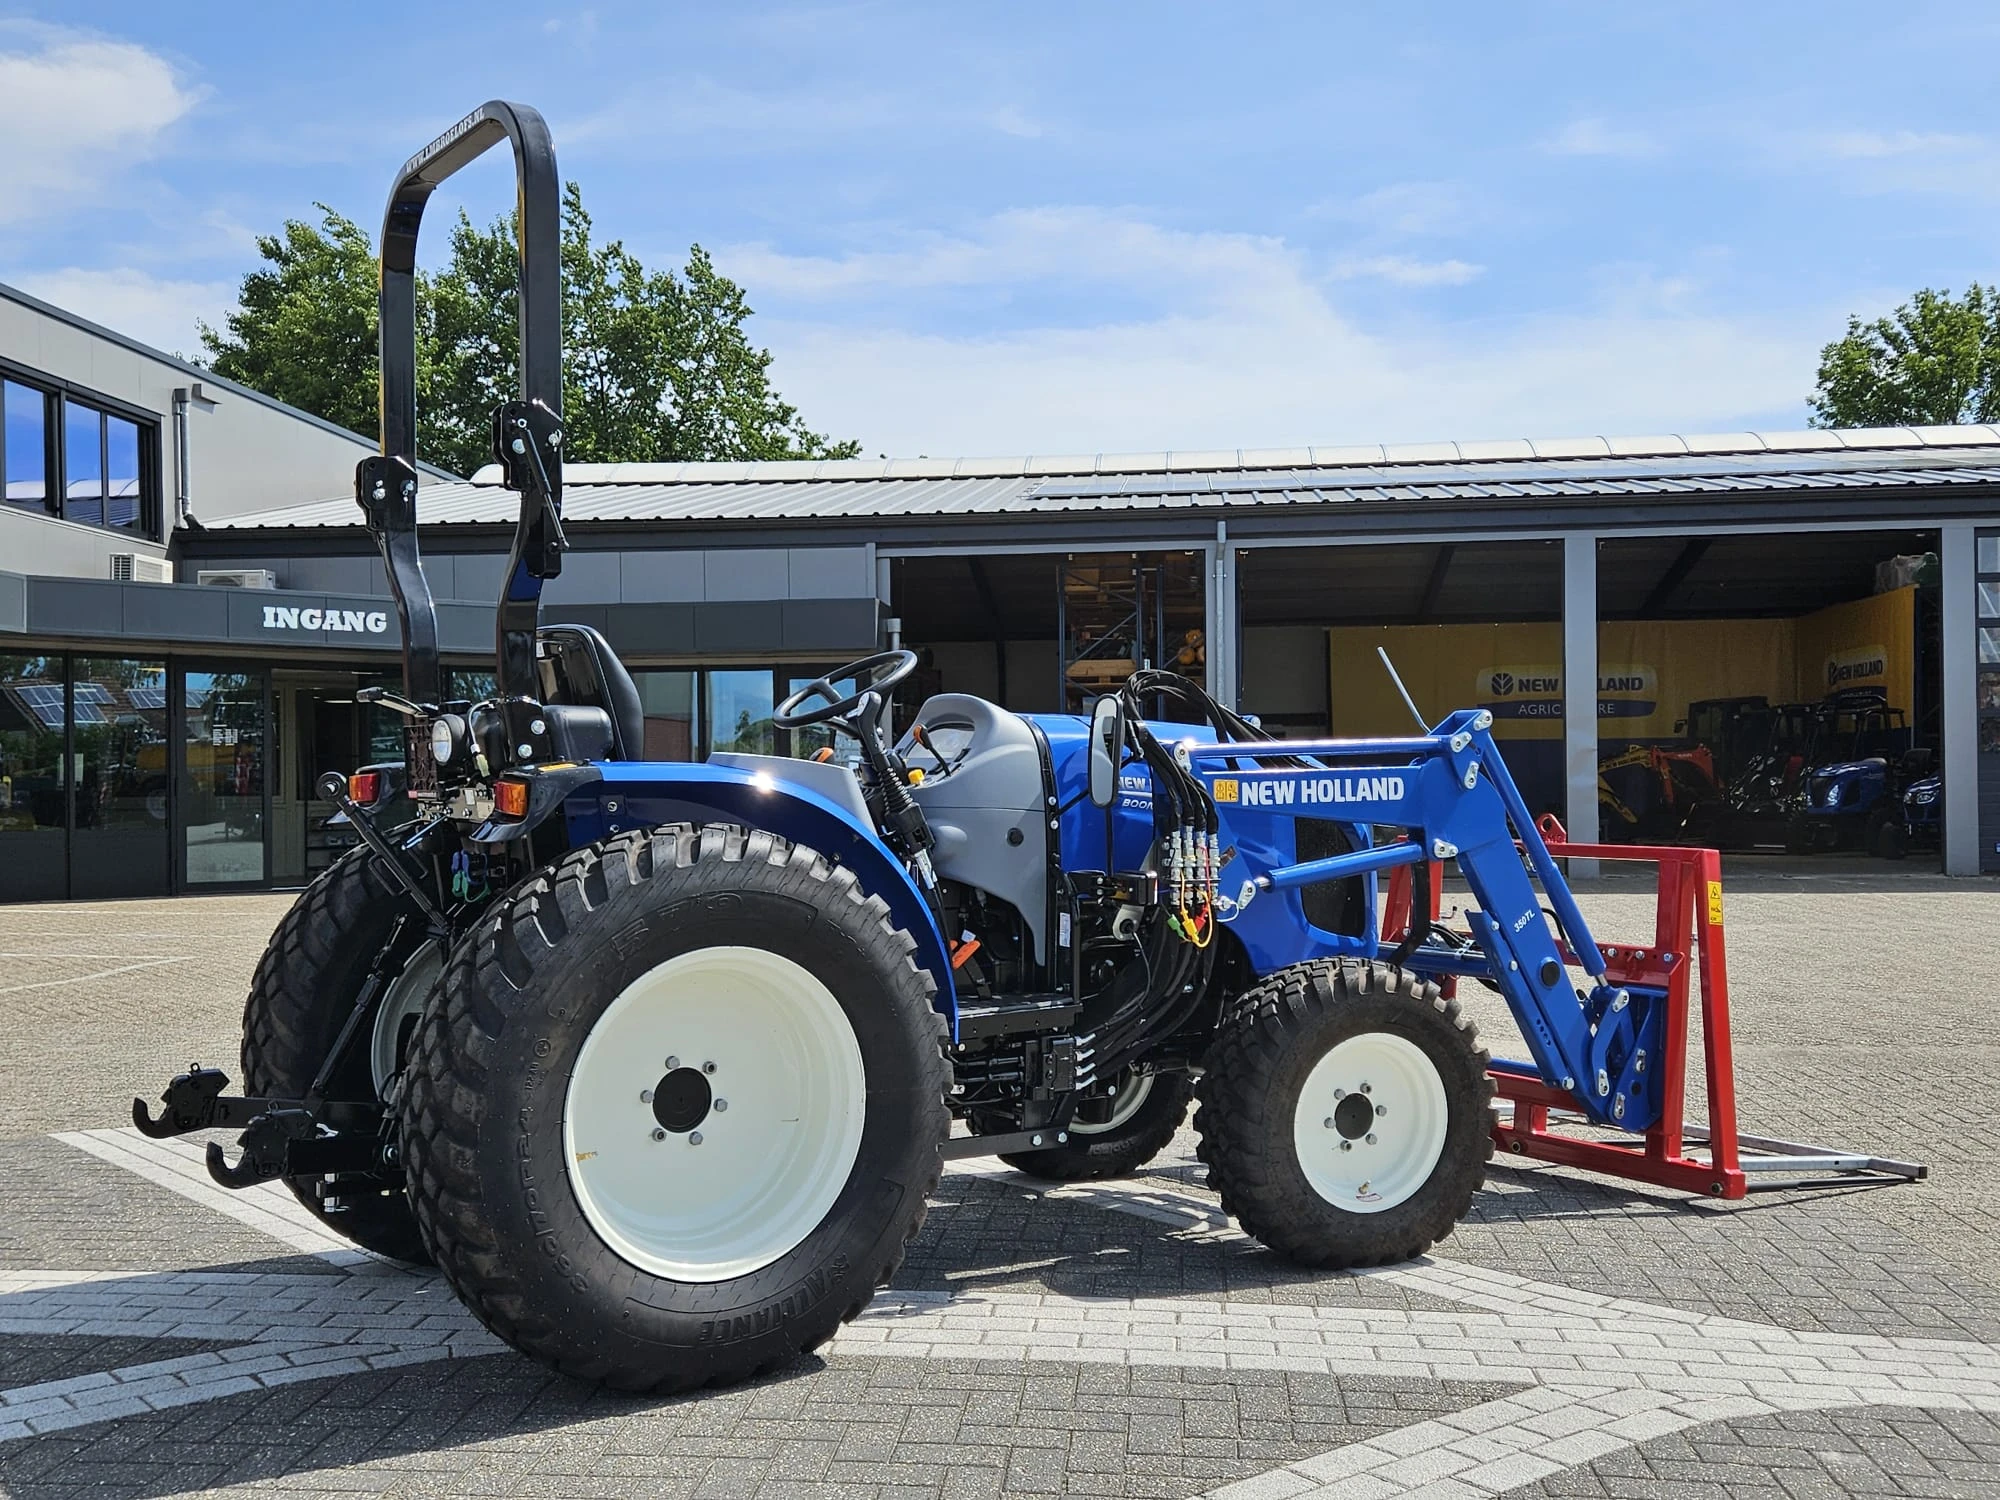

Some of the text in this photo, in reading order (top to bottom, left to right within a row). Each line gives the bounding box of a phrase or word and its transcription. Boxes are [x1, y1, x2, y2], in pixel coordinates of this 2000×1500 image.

[263, 606, 388, 633] INGANG
[1518, 678, 1559, 693] NEW
[1241, 777, 1405, 807] NEW HOLLAND
[699, 1266, 829, 1343] ALLIANCE
